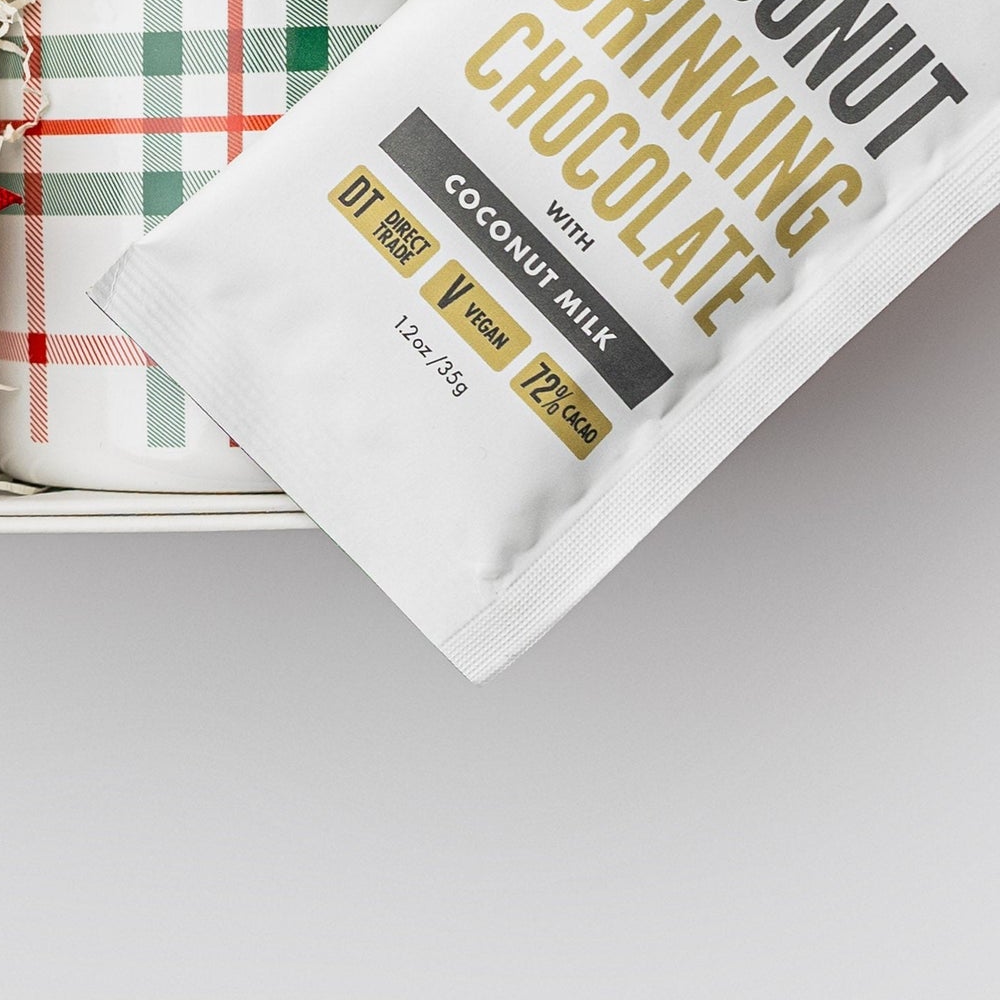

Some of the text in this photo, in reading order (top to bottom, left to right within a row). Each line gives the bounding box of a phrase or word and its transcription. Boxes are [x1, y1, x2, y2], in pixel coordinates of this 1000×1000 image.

[337, 175, 385, 218] DT
[464, 13, 776, 338] CHOCOLATE
[372, 222, 415, 266] TRADE
[384, 209, 431, 256] DIRECT
[546, 200, 595, 252] WITH
[444, 174, 617, 352] COCONUT MILK
[437, 273, 510, 350] V VEGAN
[520, 361, 598, 444] 72% CACAO
